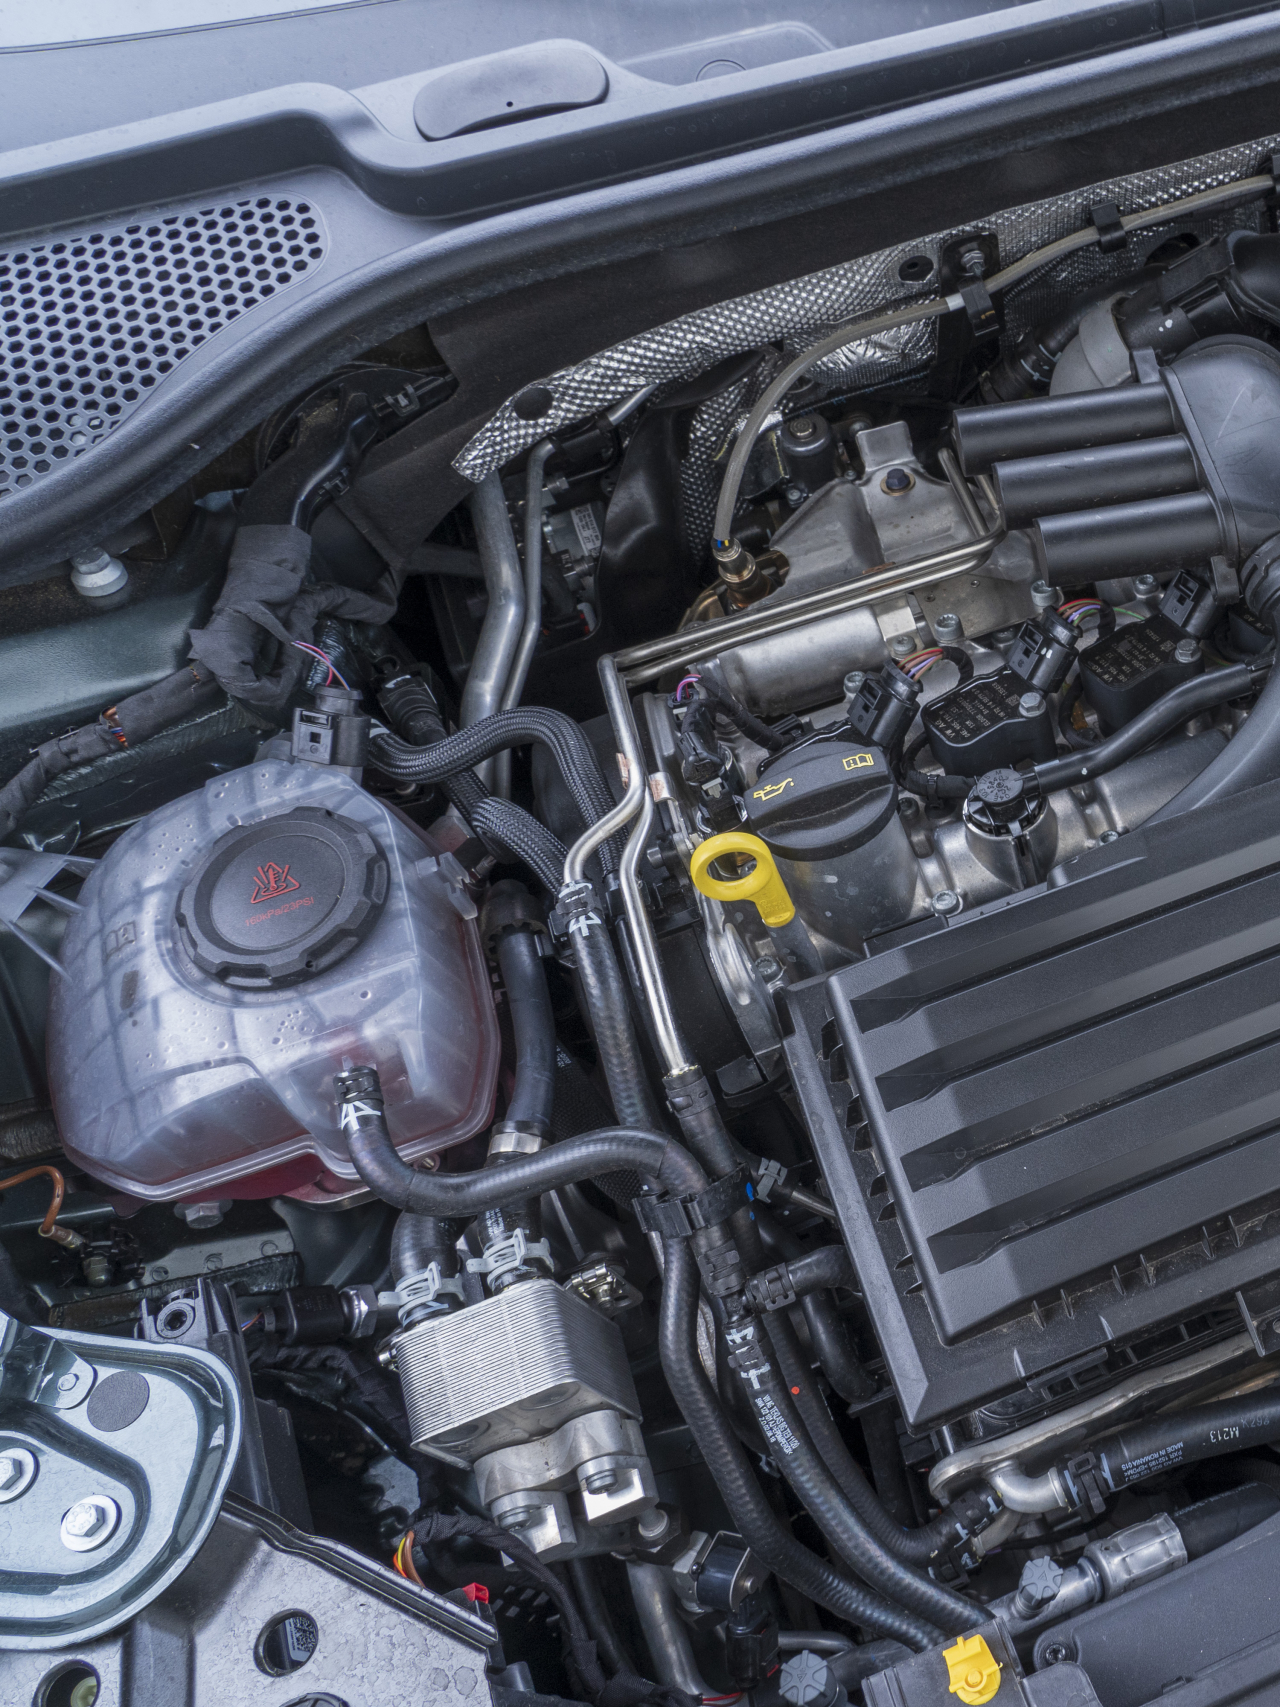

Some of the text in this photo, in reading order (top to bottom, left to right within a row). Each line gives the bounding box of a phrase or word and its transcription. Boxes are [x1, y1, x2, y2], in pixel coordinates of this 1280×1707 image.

[1242, 612, 1265, 631] VW AG
[1089, 663, 1113, 682] VW AG
[932, 718, 955, 738] VW AG
[243, 895, 315, 927] 160kPa/23PSI
[764, 1399, 775, 1409] AG
[1208, 1423, 1240, 1444] M213
[1165, 1440, 1184, 1453] MADE
[1168, 1449, 1182, 1459] PXR
[1131, 1450, 1159, 1467] ROMANIA
[1162, 1459, 1173, 1467] AG
[1172, 1455, 1183, 1463] VW
